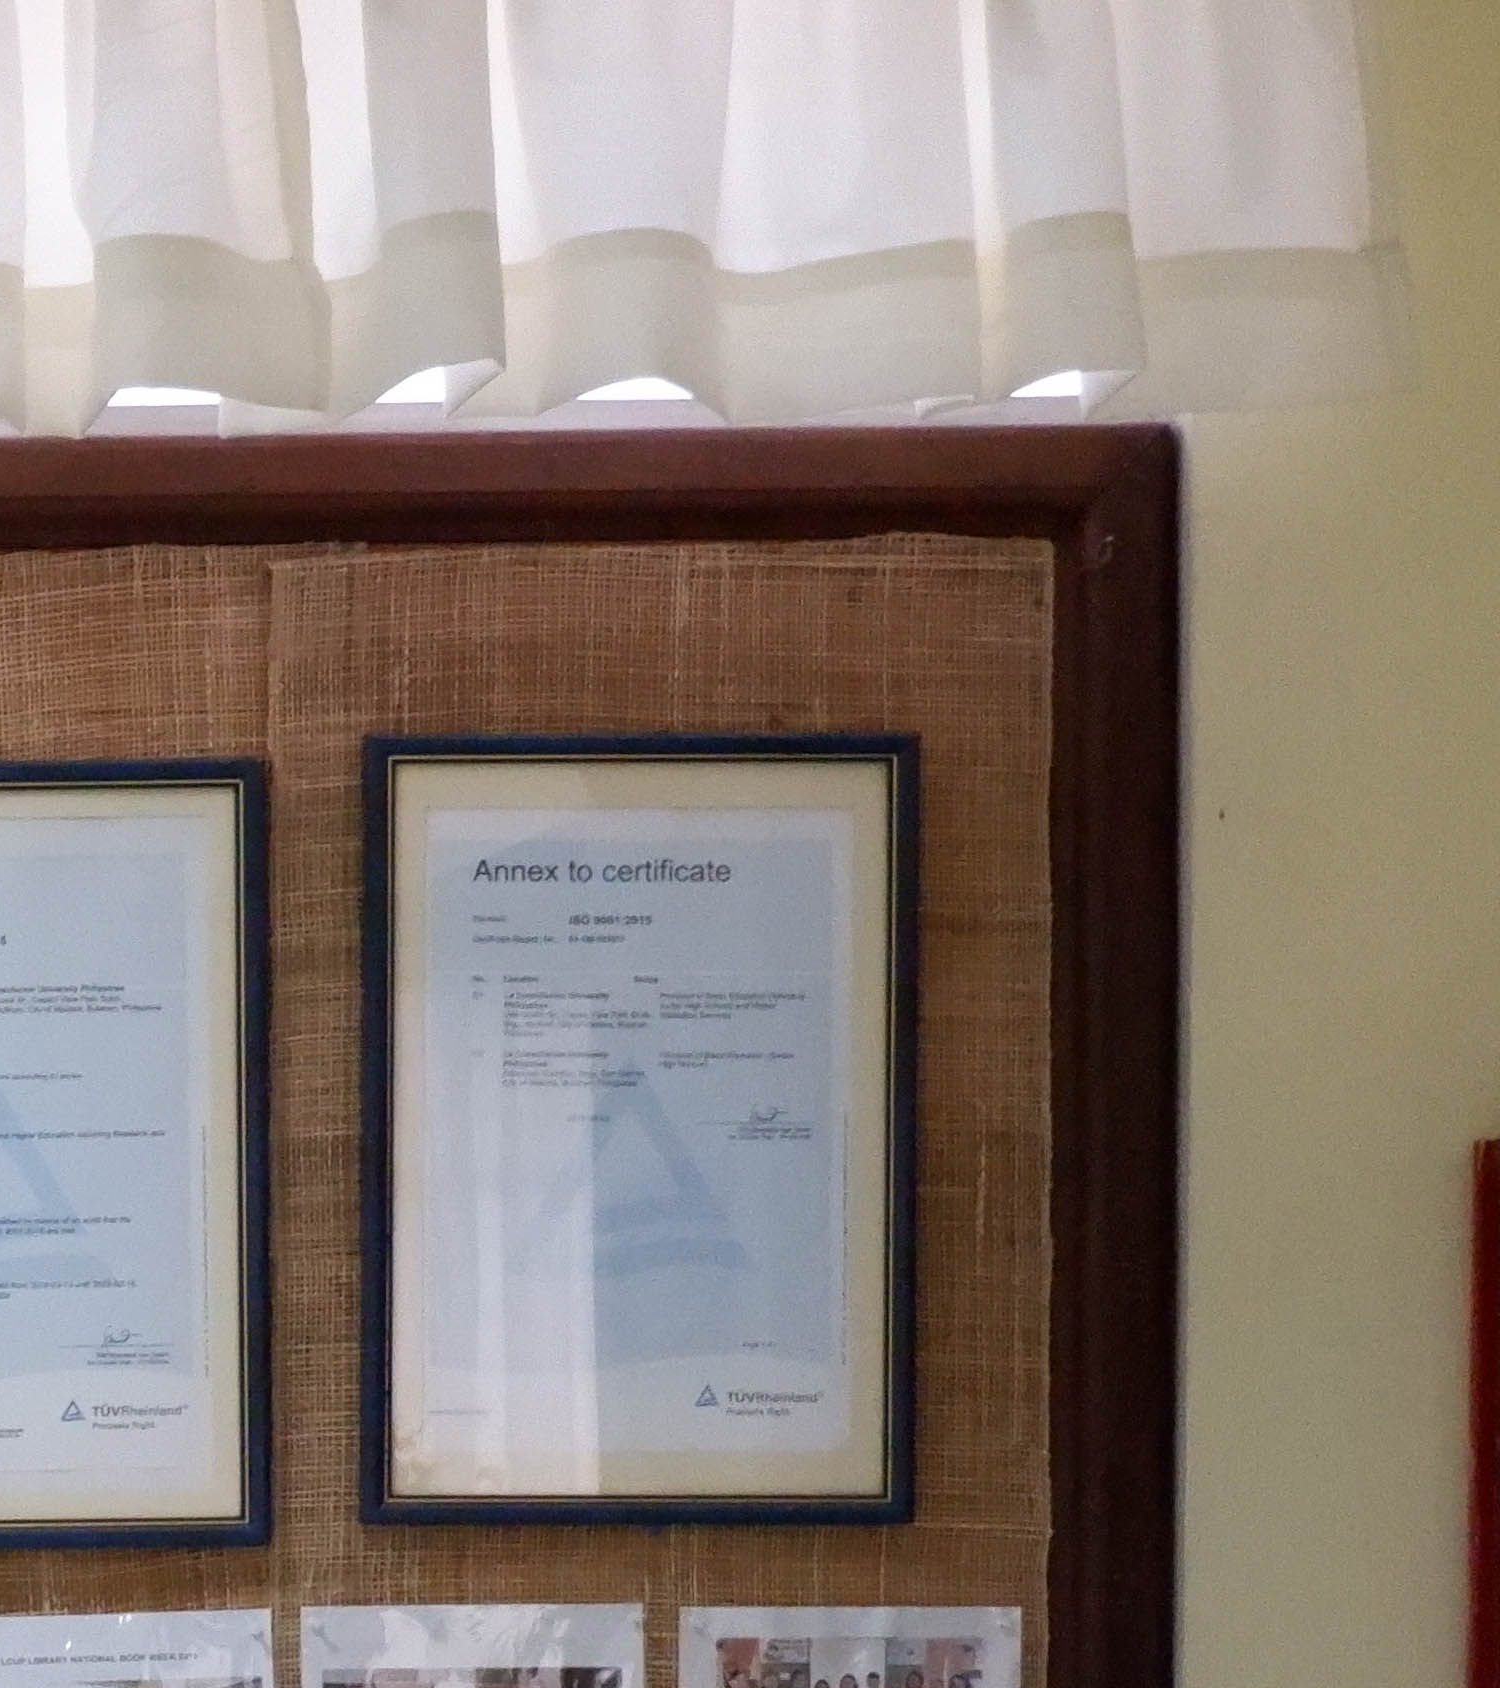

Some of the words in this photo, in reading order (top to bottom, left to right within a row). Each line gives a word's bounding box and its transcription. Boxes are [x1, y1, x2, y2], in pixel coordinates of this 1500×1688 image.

[472, 860, 558, 883] Annex
[569, 860, 593, 883] to
[602, 858, 731, 883] certificate
